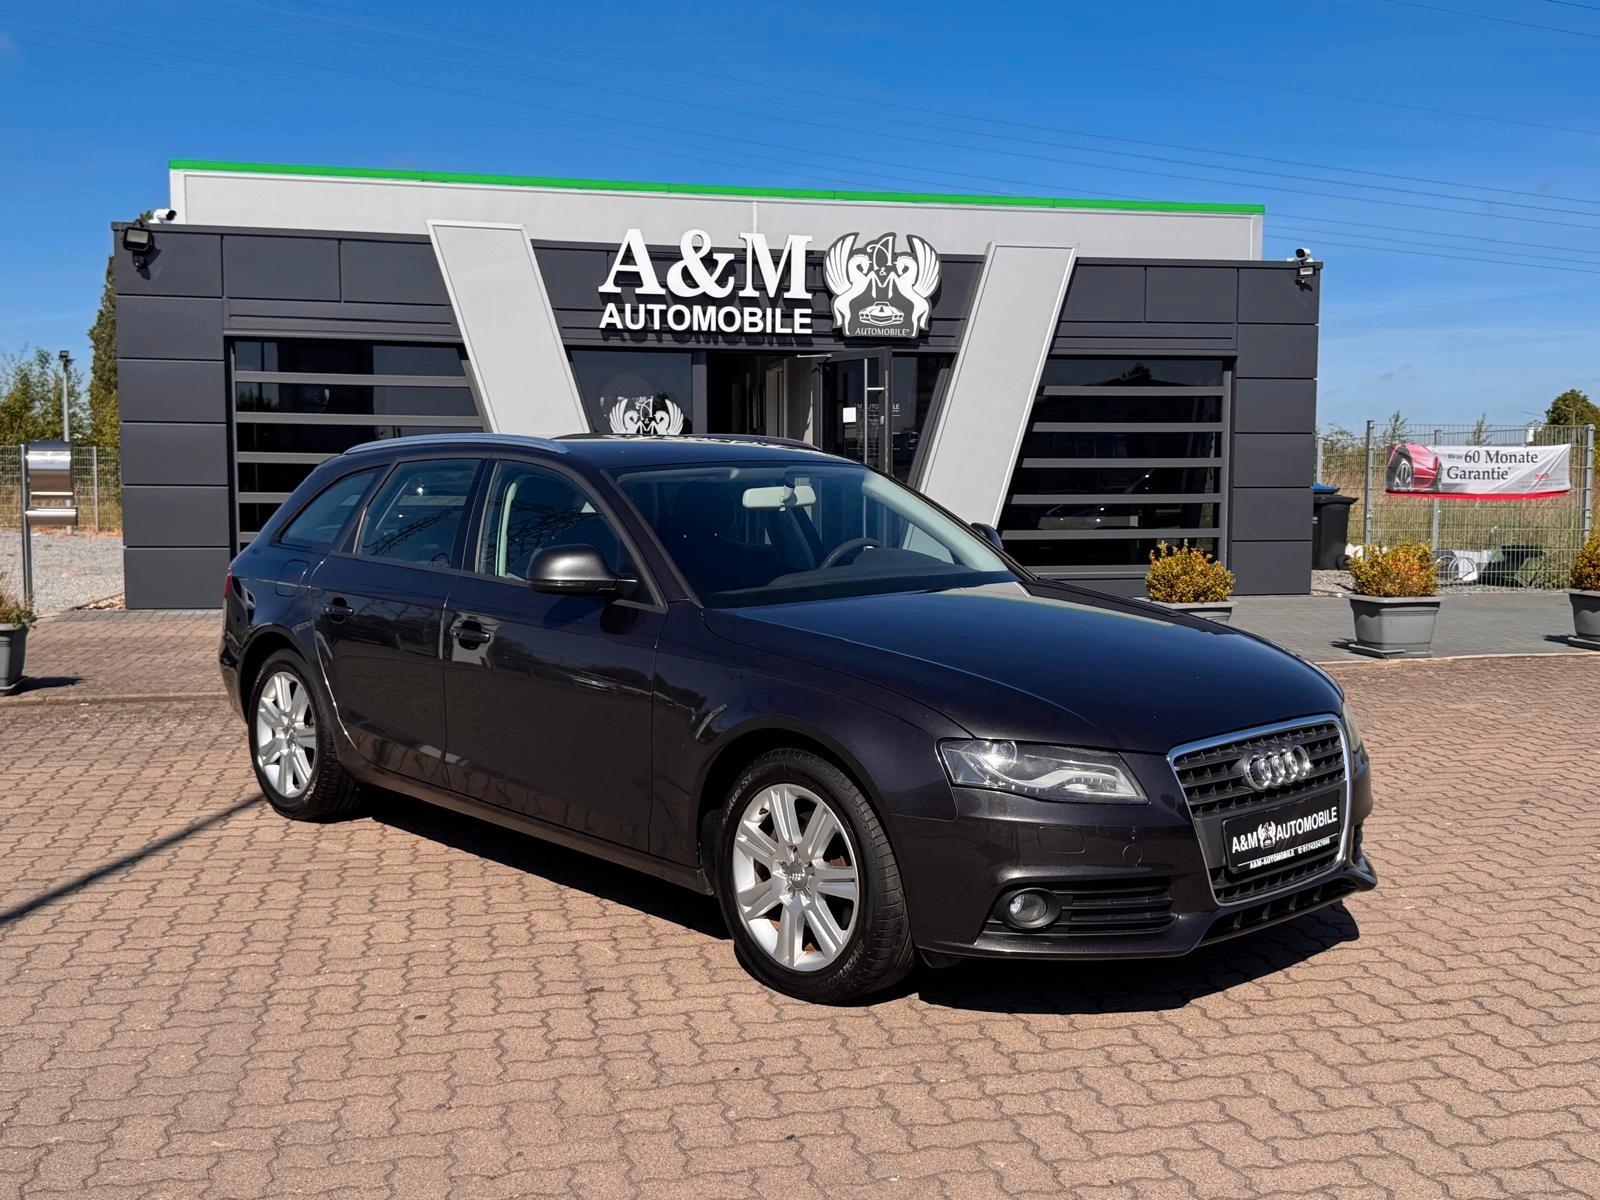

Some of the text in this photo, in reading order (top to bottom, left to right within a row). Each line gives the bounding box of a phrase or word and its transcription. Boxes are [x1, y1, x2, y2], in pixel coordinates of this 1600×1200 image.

[598, 228, 813, 300] A&M
[599, 302, 813, 335] AUTOMOBILE
[1464, 450, 1480, 464] 60
[1485, 450, 1538, 464] Monate
[1232, 806, 1338, 854] A&M AUTOMOBILE
